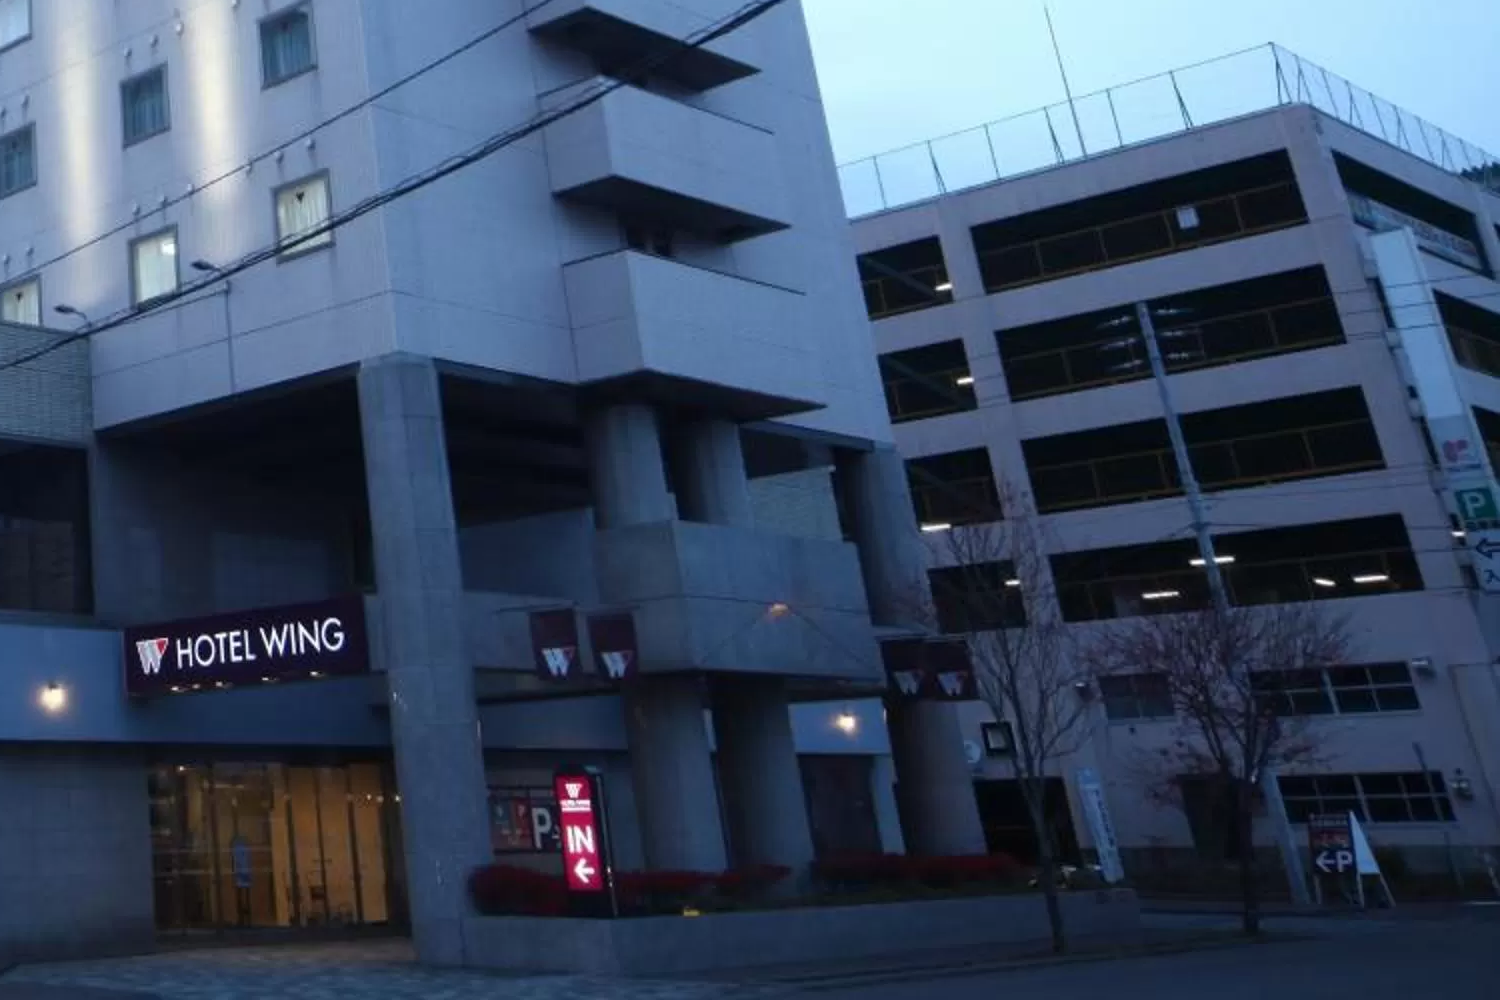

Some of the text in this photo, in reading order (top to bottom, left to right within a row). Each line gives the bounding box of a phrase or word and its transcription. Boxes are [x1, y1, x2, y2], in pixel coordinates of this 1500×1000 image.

[1462, 491, 1487, 518] P
[176, 628, 256, 669] HOTEL
[259, 617, 346, 659] WING
[531, 807, 553, 850] P
[566, 825, 595, 854] IN
[1336, 850, 1353, 873] P
